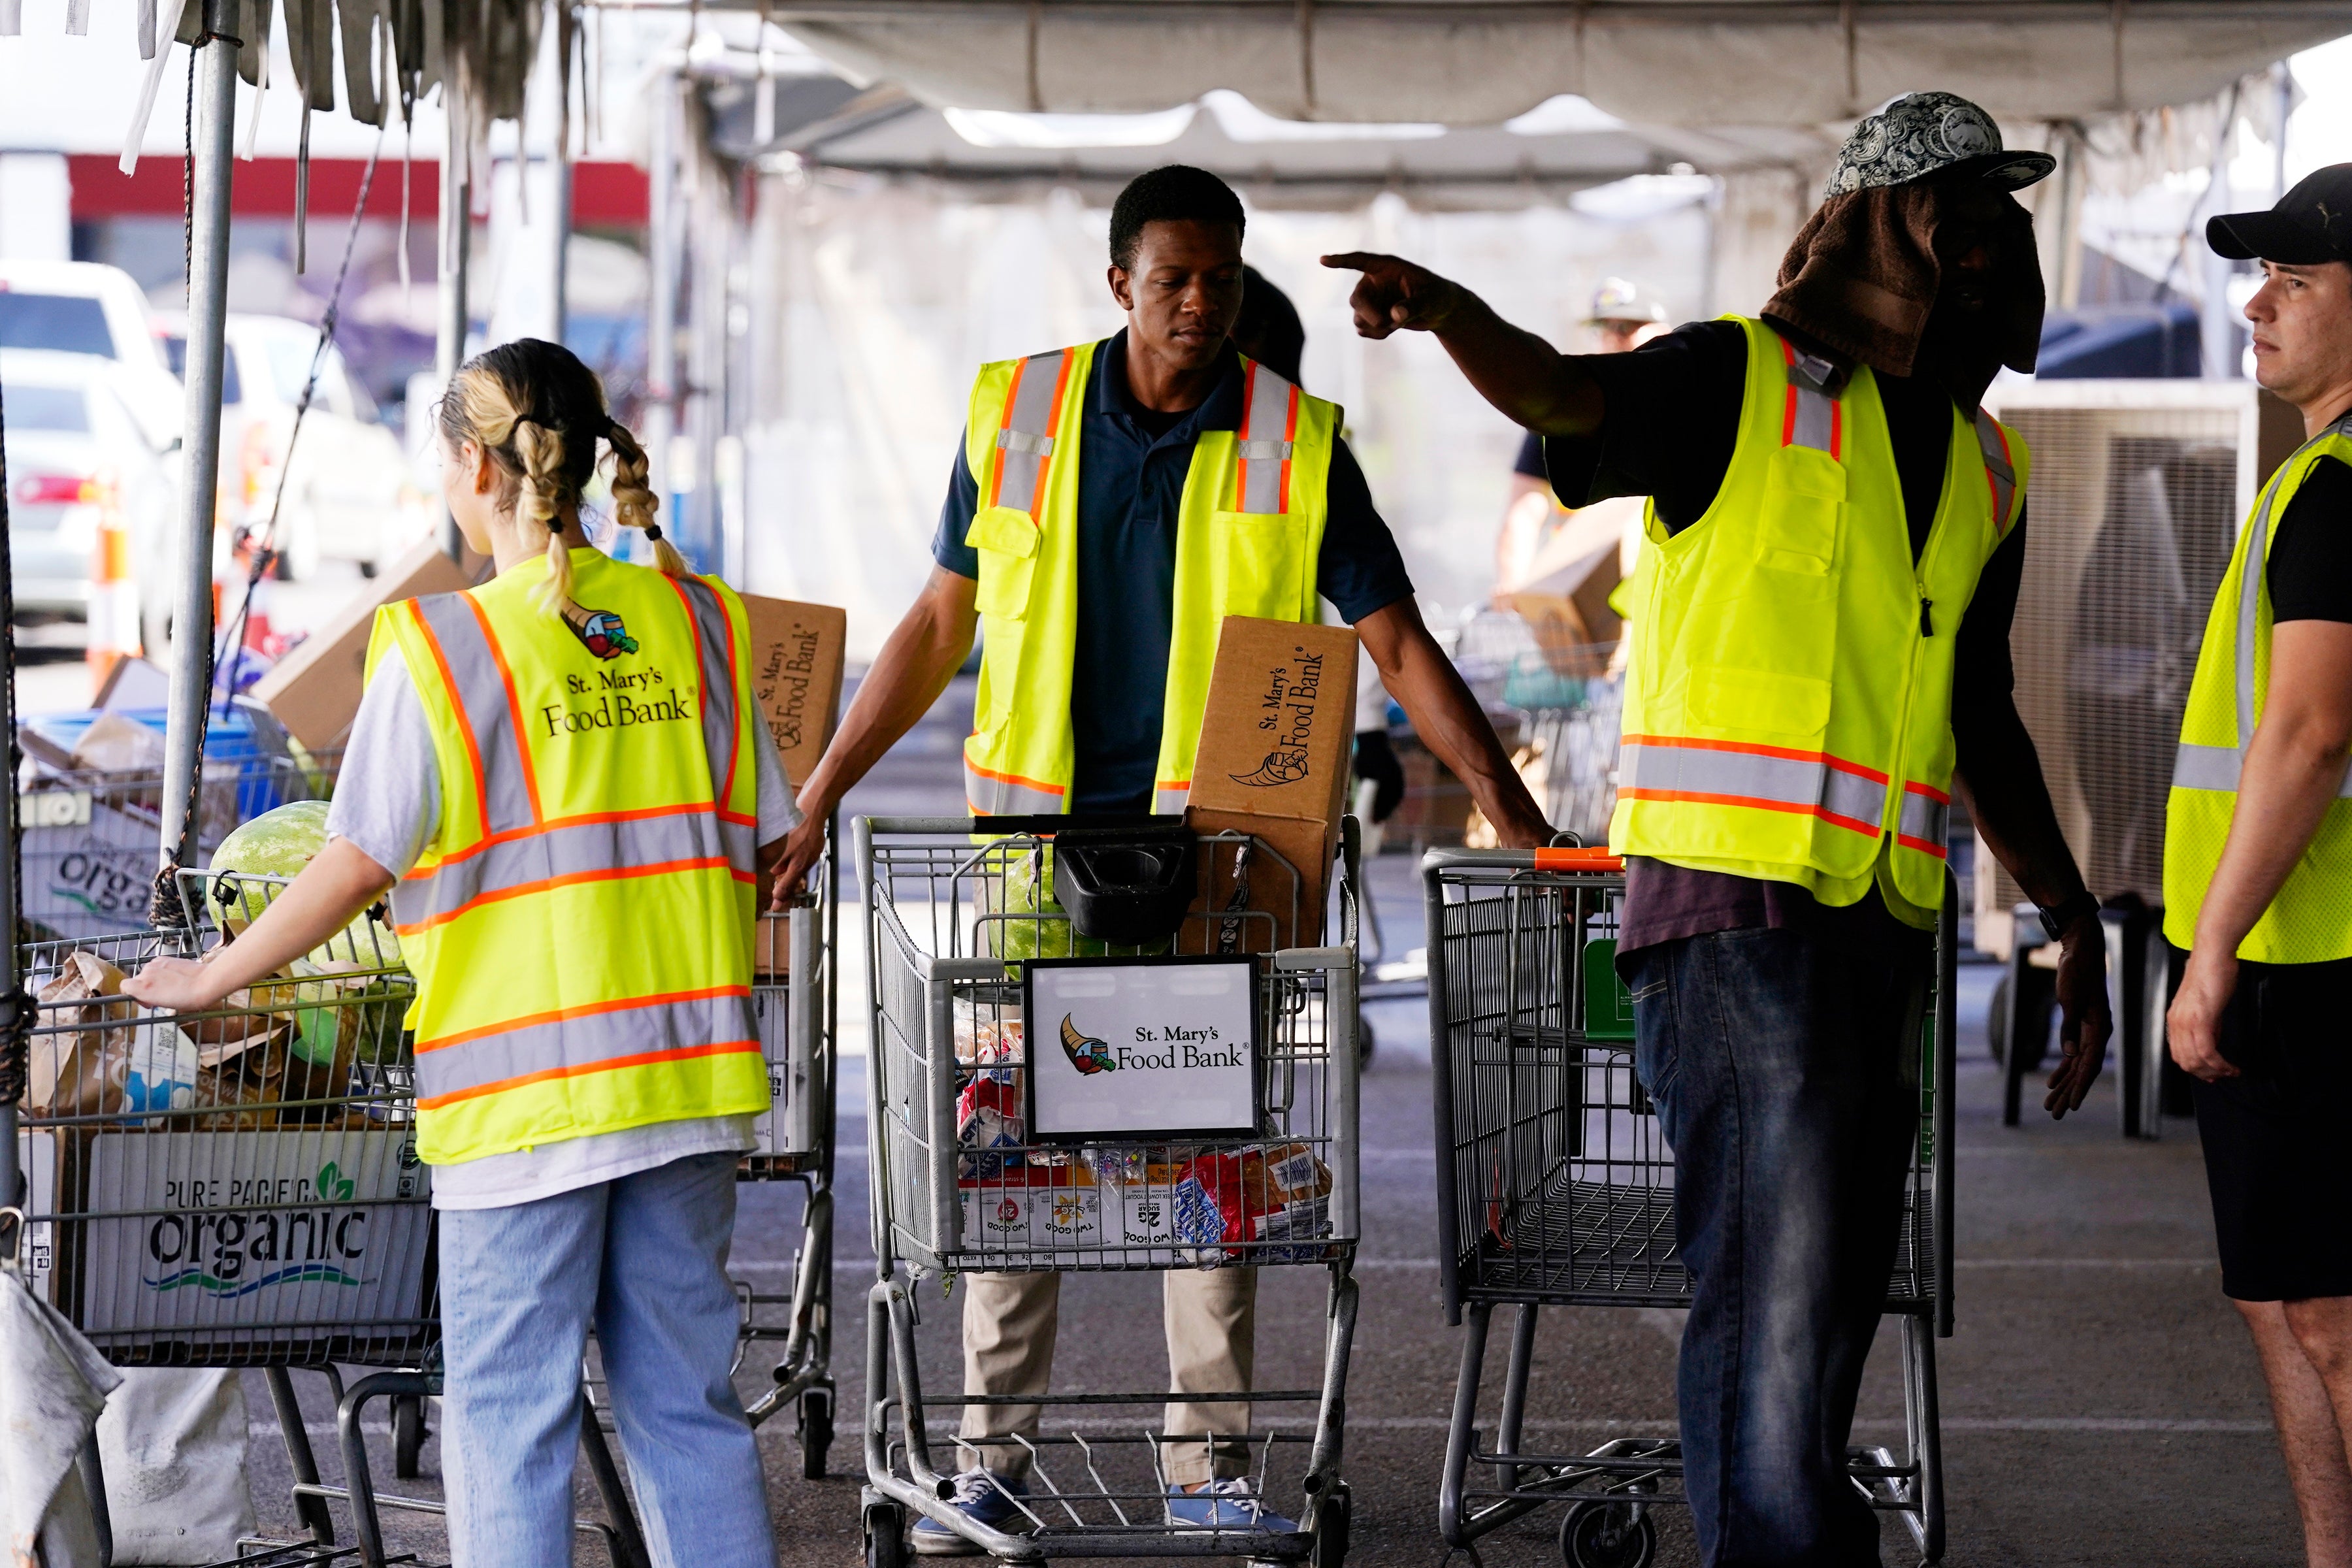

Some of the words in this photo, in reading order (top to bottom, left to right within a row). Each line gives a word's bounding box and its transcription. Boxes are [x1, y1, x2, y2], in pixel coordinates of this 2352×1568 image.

[762, 642, 787, 682] Mary's
[787, 630, 820, 674] Bank
[567, 674, 592, 694] St.
[598, 666, 662, 691] Mary's
[1262, 668, 1290, 710] Mary's
[1288, 653, 1323, 700] Bank
[776, 674, 809, 720] Food
[542, 696, 614, 738] Food
[616, 688, 692, 727] Bank
[1259, 713, 1278, 730] St.
[1280, 702, 1315, 749] Food
[1135, 1026, 1158, 1042] St.
[1164, 1025, 1218, 1044] Mary's
[1117, 1045, 1176, 1070] Food
[1183, 1043, 1244, 1068] Bank
[229, 1178, 310, 1206] PACIFC
[987, 1222, 1011, 1232] GOOD
[1045, 1223, 1071, 1234] GOOD
[1073, 1222, 1094, 1233] TWO
[1138, 1211, 1160, 1228] 2G
[150, 1211, 366, 1279] organic
[1153, 1233, 1171, 1243] WO
